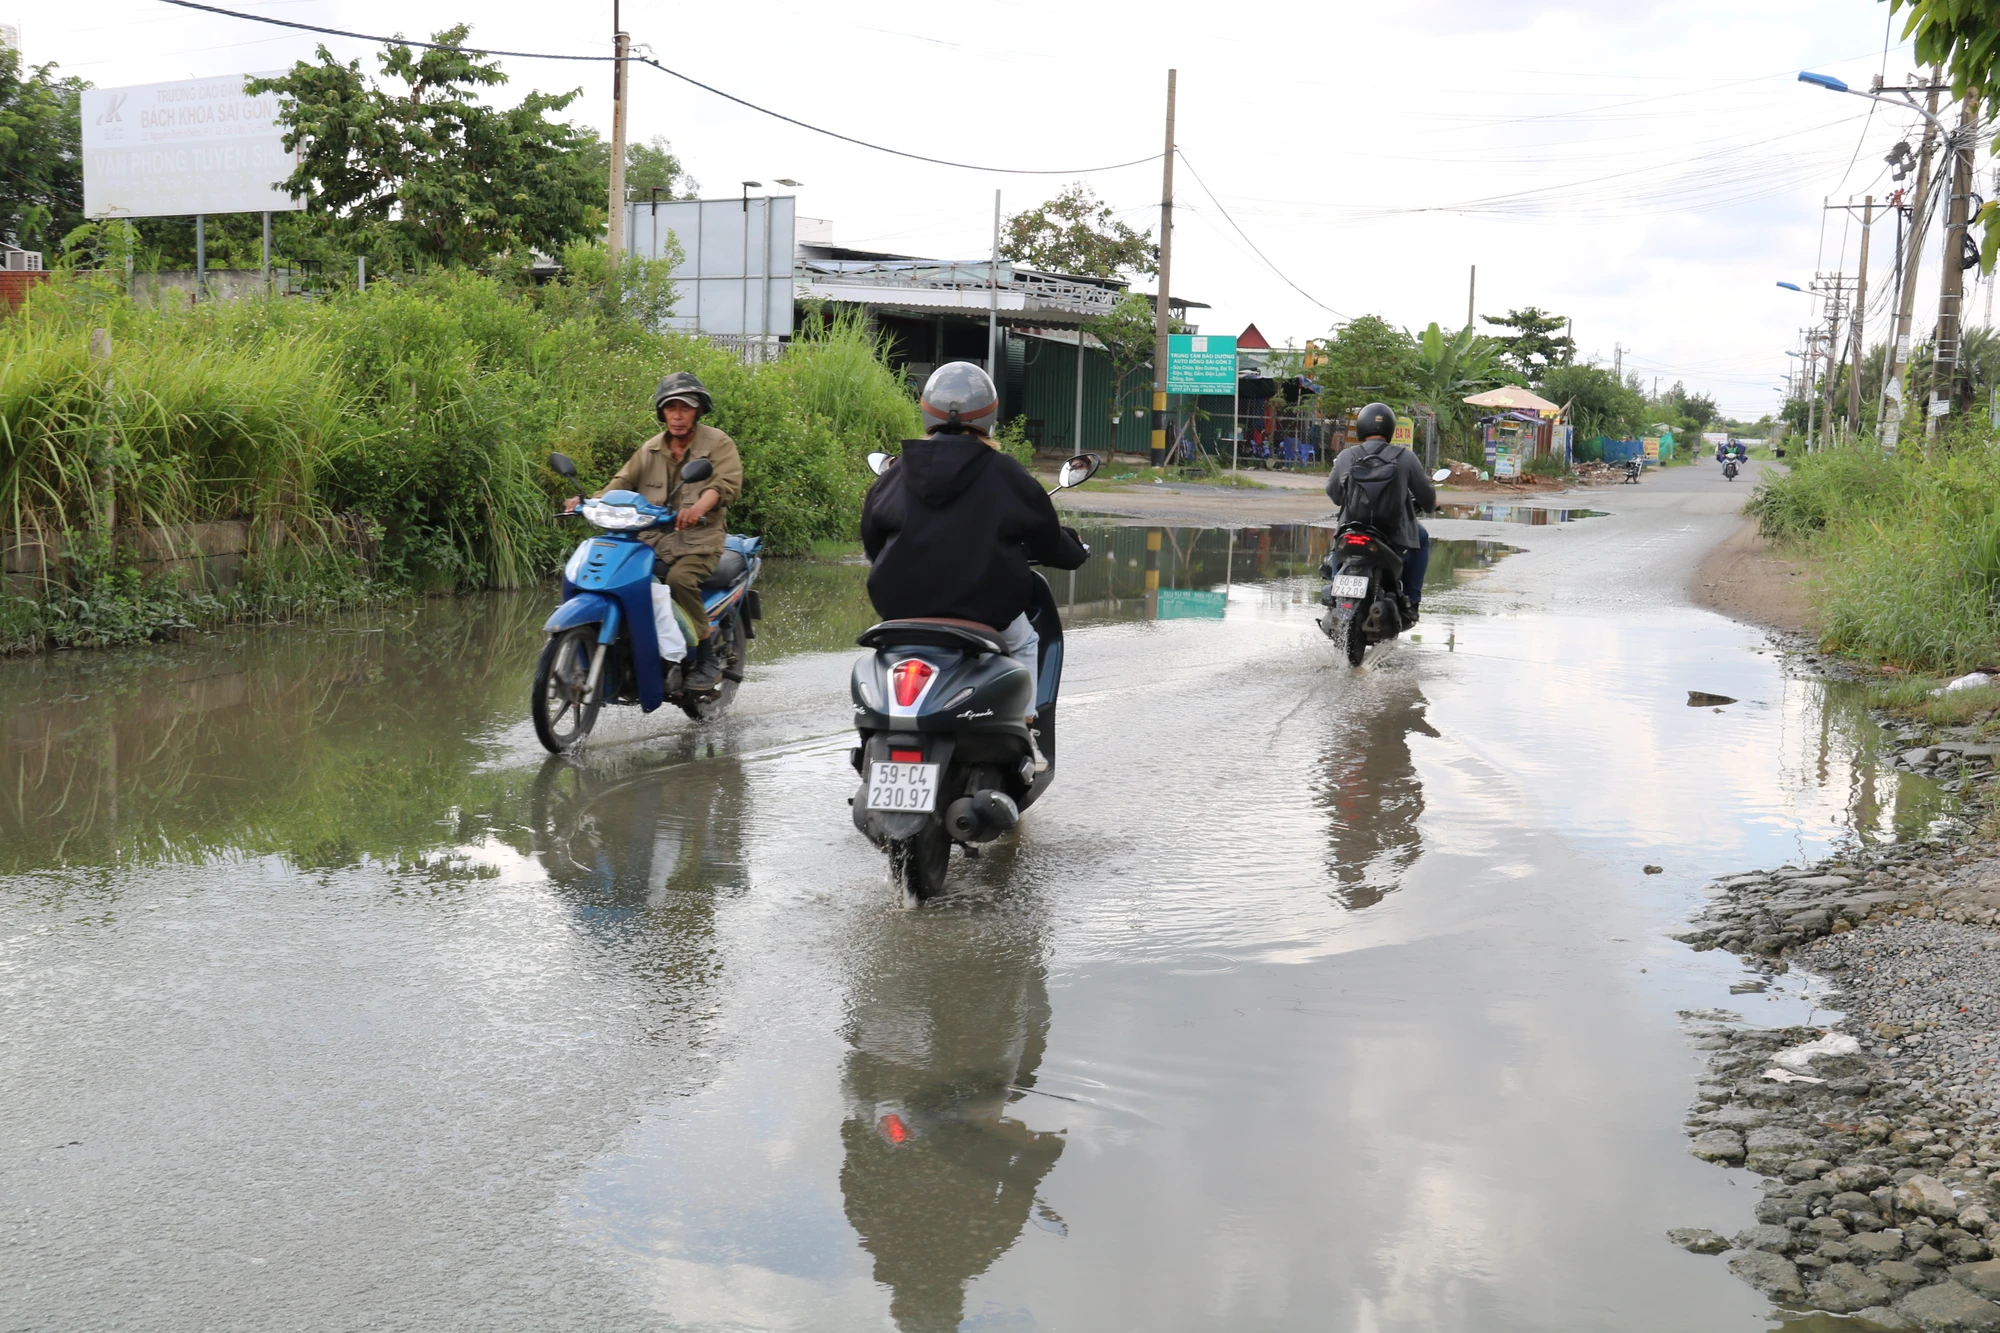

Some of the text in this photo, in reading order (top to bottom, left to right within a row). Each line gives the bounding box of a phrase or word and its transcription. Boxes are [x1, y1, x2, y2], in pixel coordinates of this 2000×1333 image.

[198, 84, 219, 100] CAO
[142, 105, 175, 129] BÁCH
[179, 105, 215, 126] KHOA
[217, 98, 239, 123] SÀI
[94, 144, 292, 177] VĂN PHÒNG TUYỂN SINH
[1395, 426, 1411, 439] GÀ TA
[1334, 586, 1364, 596] 742.09
[879, 765, 927, 786] 59-C4
[872, 787, 930, 809] 230.97
